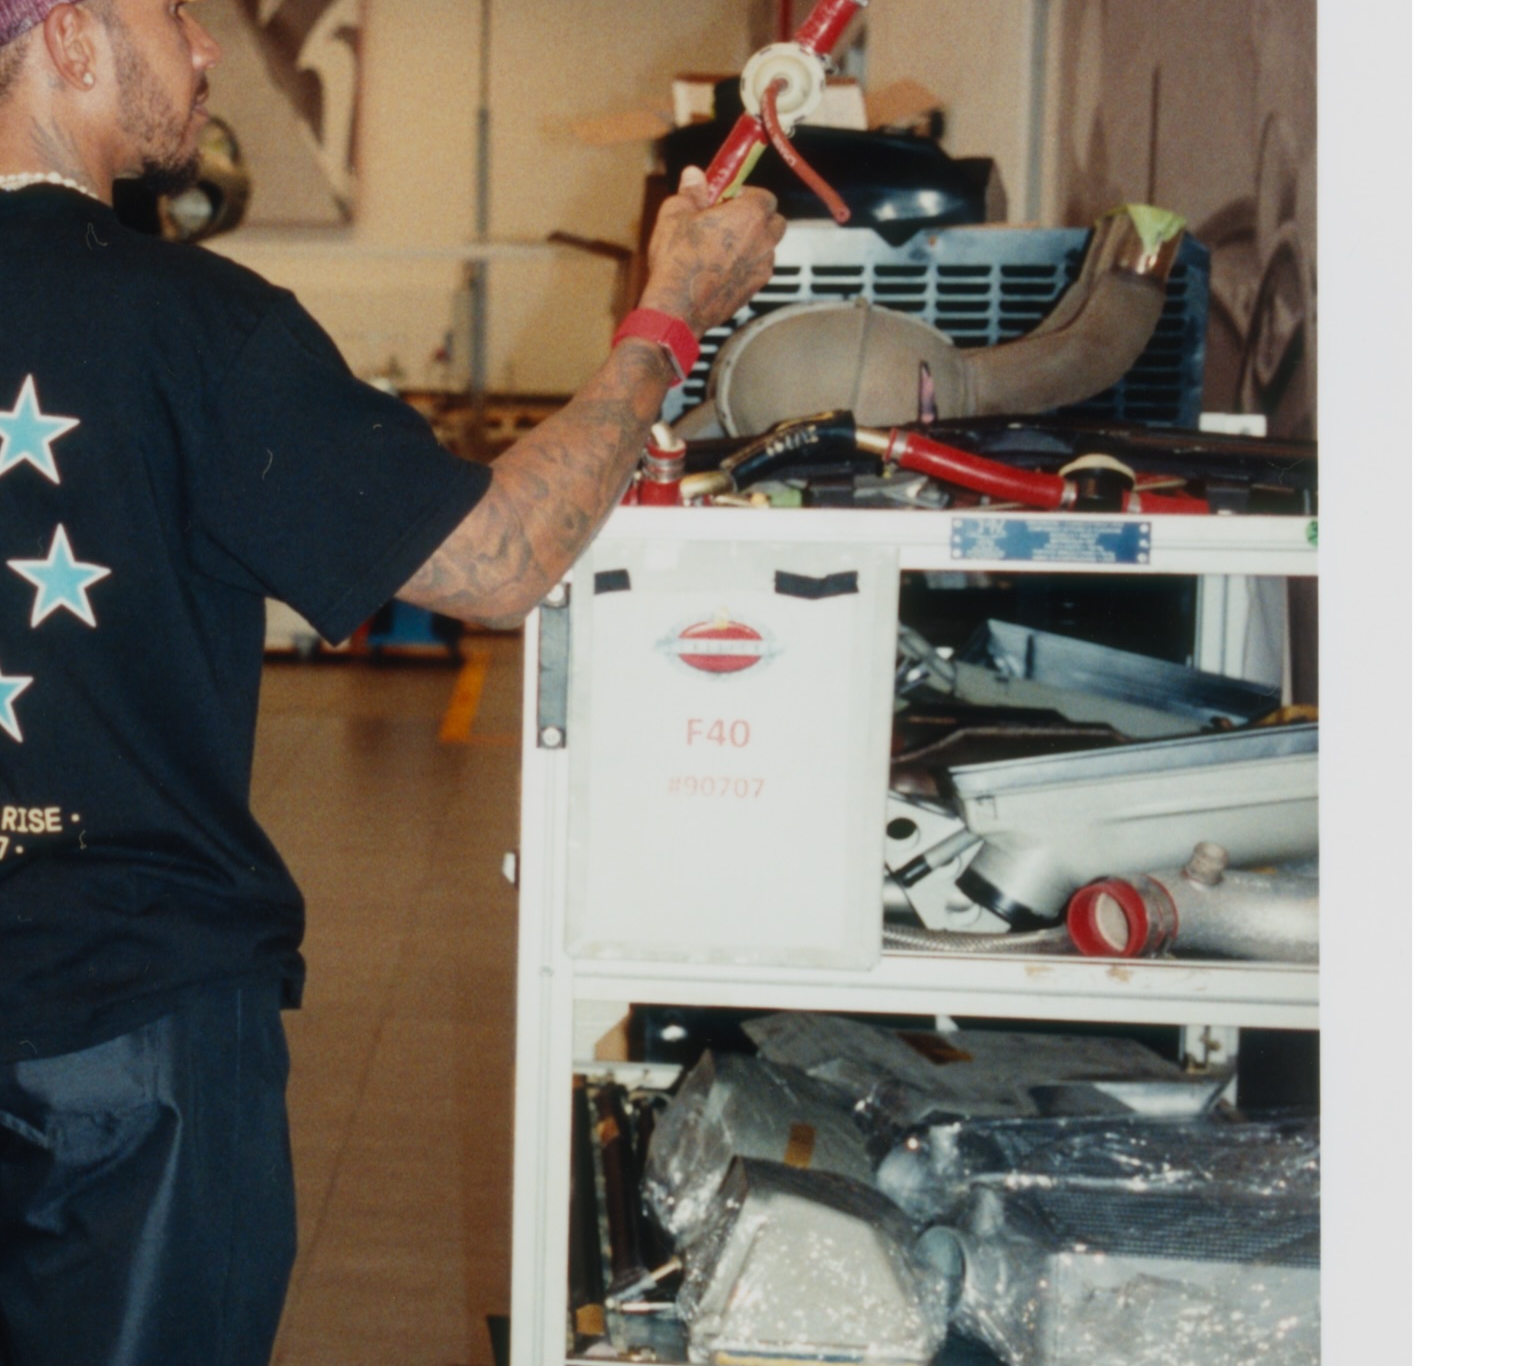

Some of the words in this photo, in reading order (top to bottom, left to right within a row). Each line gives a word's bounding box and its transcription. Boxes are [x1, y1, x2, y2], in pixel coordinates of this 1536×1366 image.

[686, 717, 752, 748] F40
[667, 775, 765, 800] #90707
[1, 806, 64, 834] RISE
